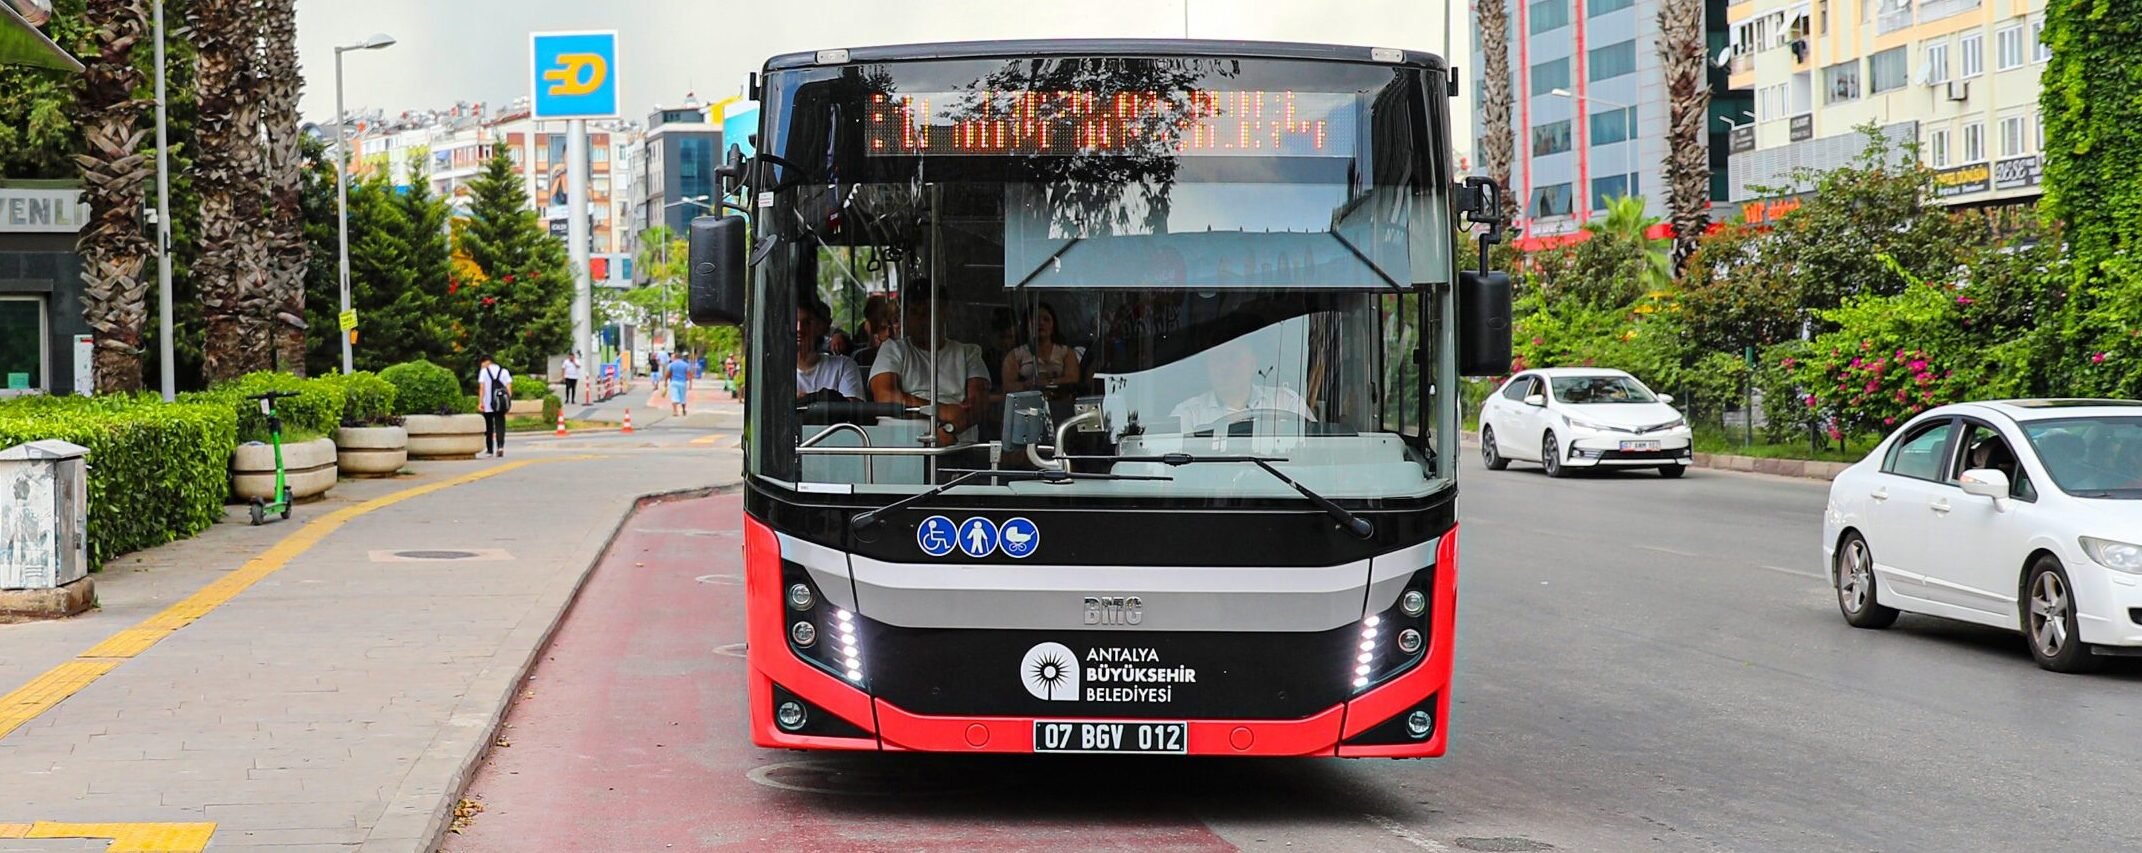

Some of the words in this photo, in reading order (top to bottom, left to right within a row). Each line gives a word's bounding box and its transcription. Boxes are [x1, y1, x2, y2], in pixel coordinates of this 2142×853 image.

[1084, 597, 1142, 625] BMC
[1086, 648, 1159, 662] ANTALYA
[1086, 685, 1172, 702] BELEDİYESİ
[1045, 724, 1073, 749] 07
[1081, 724, 1124, 749] BGV
[1138, 725, 1180, 750] 012
